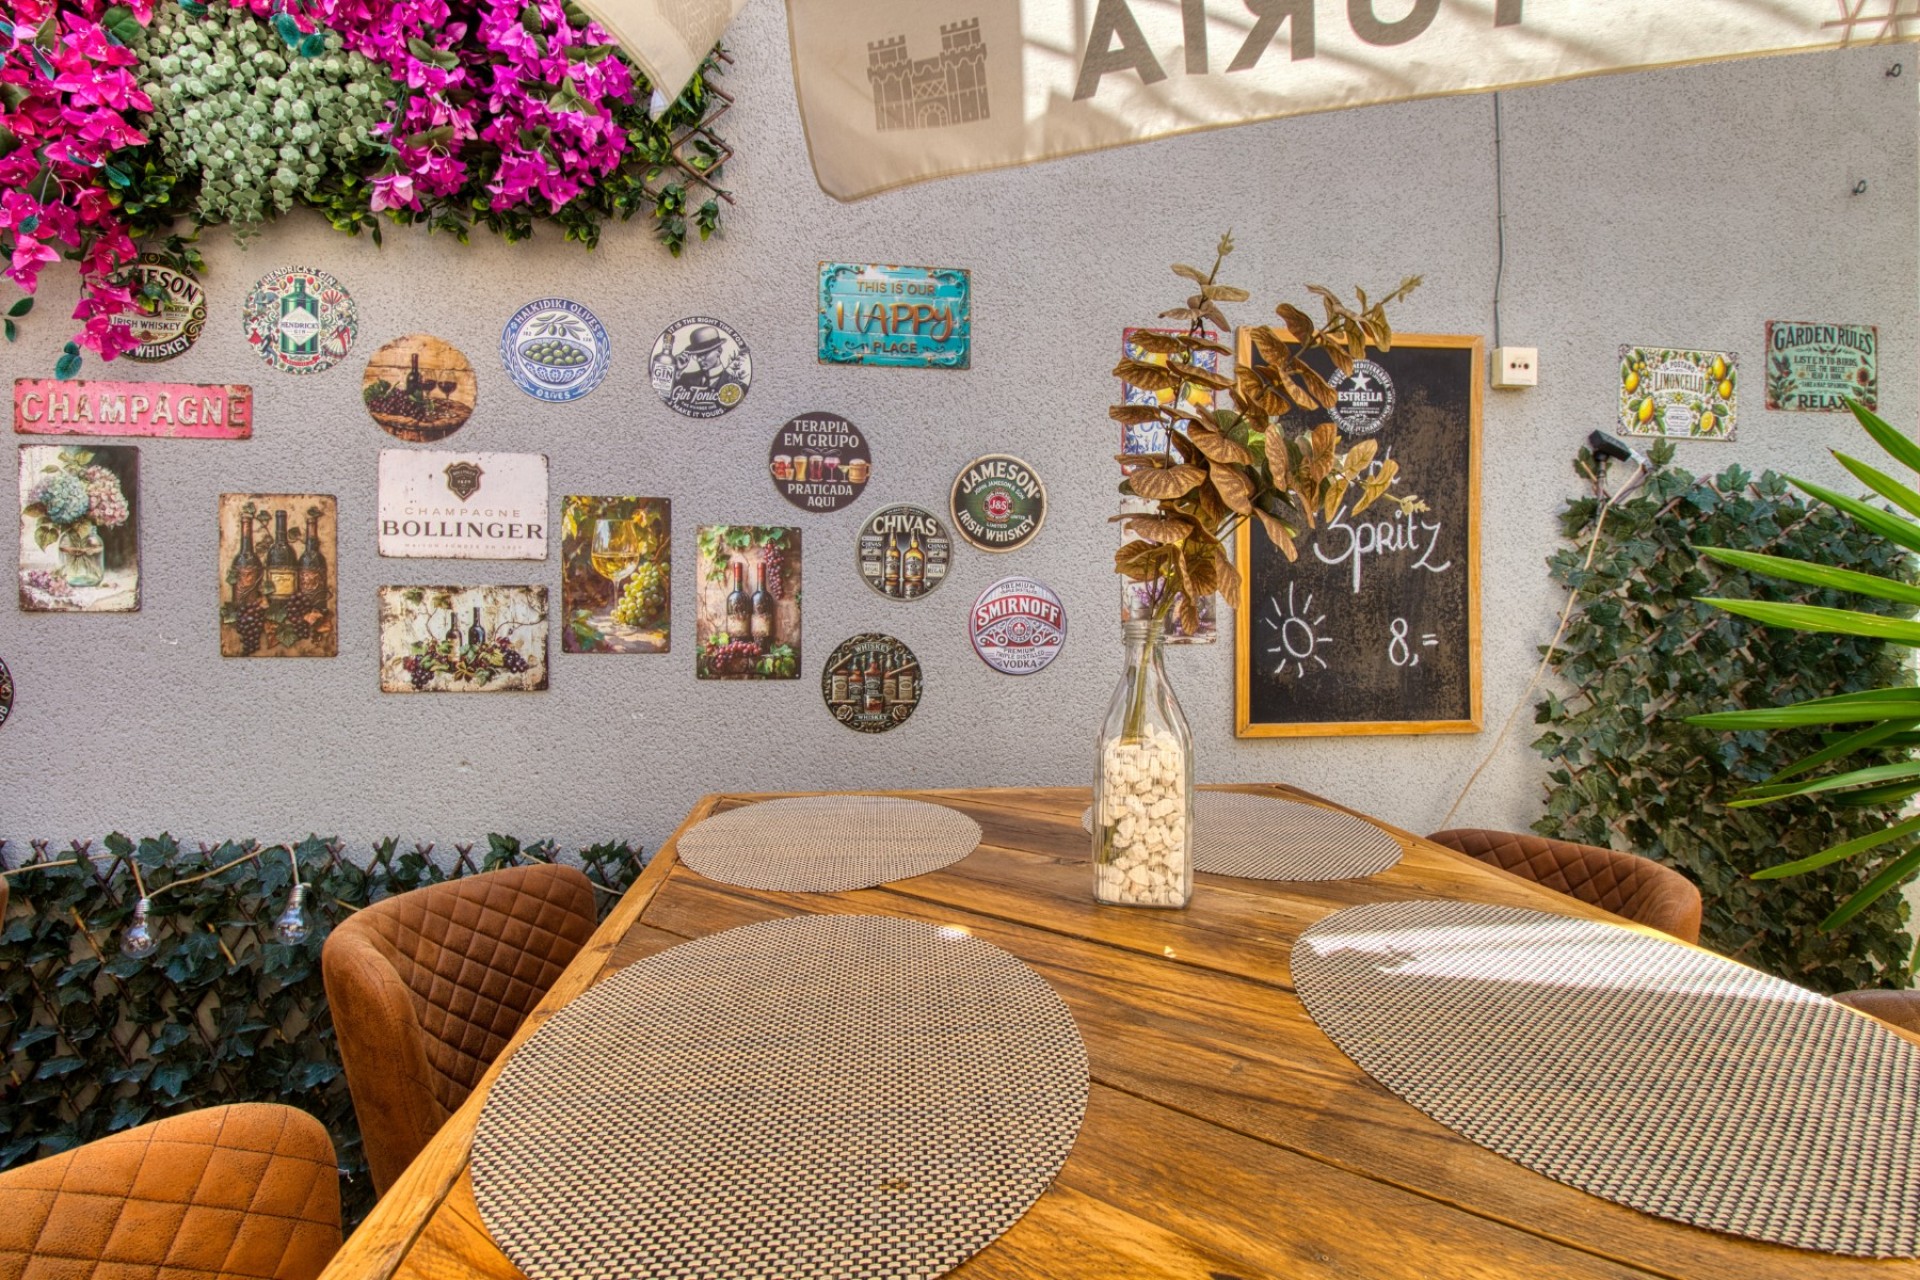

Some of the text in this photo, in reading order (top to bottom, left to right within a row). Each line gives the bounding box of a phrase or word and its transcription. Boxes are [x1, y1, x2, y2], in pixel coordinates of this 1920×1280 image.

[318, 271, 338, 286] GIN
[857, 281, 935, 296] THIS IS OUR
[514, 299, 601, 332] HALKIDIKI OLIVES
[113, 316, 181, 331] IRISH WHISKEY
[697, 317, 719, 325] RIGHT
[719, 322, 734, 334] TIME
[732, 333, 744, 346] FOR
[135, 334, 191, 357] WHISKEY
[873, 341, 918, 354] PLACE
[1774, 325, 1873, 355] GARDEN RULES
[1794, 355, 1826, 365] LISTEN
[654, 368, 673, 379] GIN
[1654, 371, 1705, 394] LIMONCELLO
[672, 385, 720, 404] Gin Tonic
[1338, 391, 1383, 402] ESTRELLA
[1797, 393, 1850, 410] RELAX
[21, 392, 248, 428] CHAMPAGNE
[672, 404, 692, 416] MAKE
[701, 407, 725, 418] YOURS
[793, 420, 849, 433] TERAPIA
[783, 433, 860, 448] EM GRUPO
[961, 461, 1040, 499] JAMESON
[787, 483, 853, 496] PRATICADA
[807, 496, 836, 508] AQUI
[990, 499, 1008, 510] J&S
[404, 507, 522, 518] CHAMPAGNE
[382, 519, 545, 540] BOLLINGER
[872, 515, 937, 537] CHIVAS
[957, 509, 1036, 542] IRISH WHISKEY
[1000, 582, 1036, 590] PREMIUM
[977, 597, 1059, 626] SMIRNOFF
[854, 643, 891, 653] WHISKEY
[1003, 659, 1038, 669] VODKA
